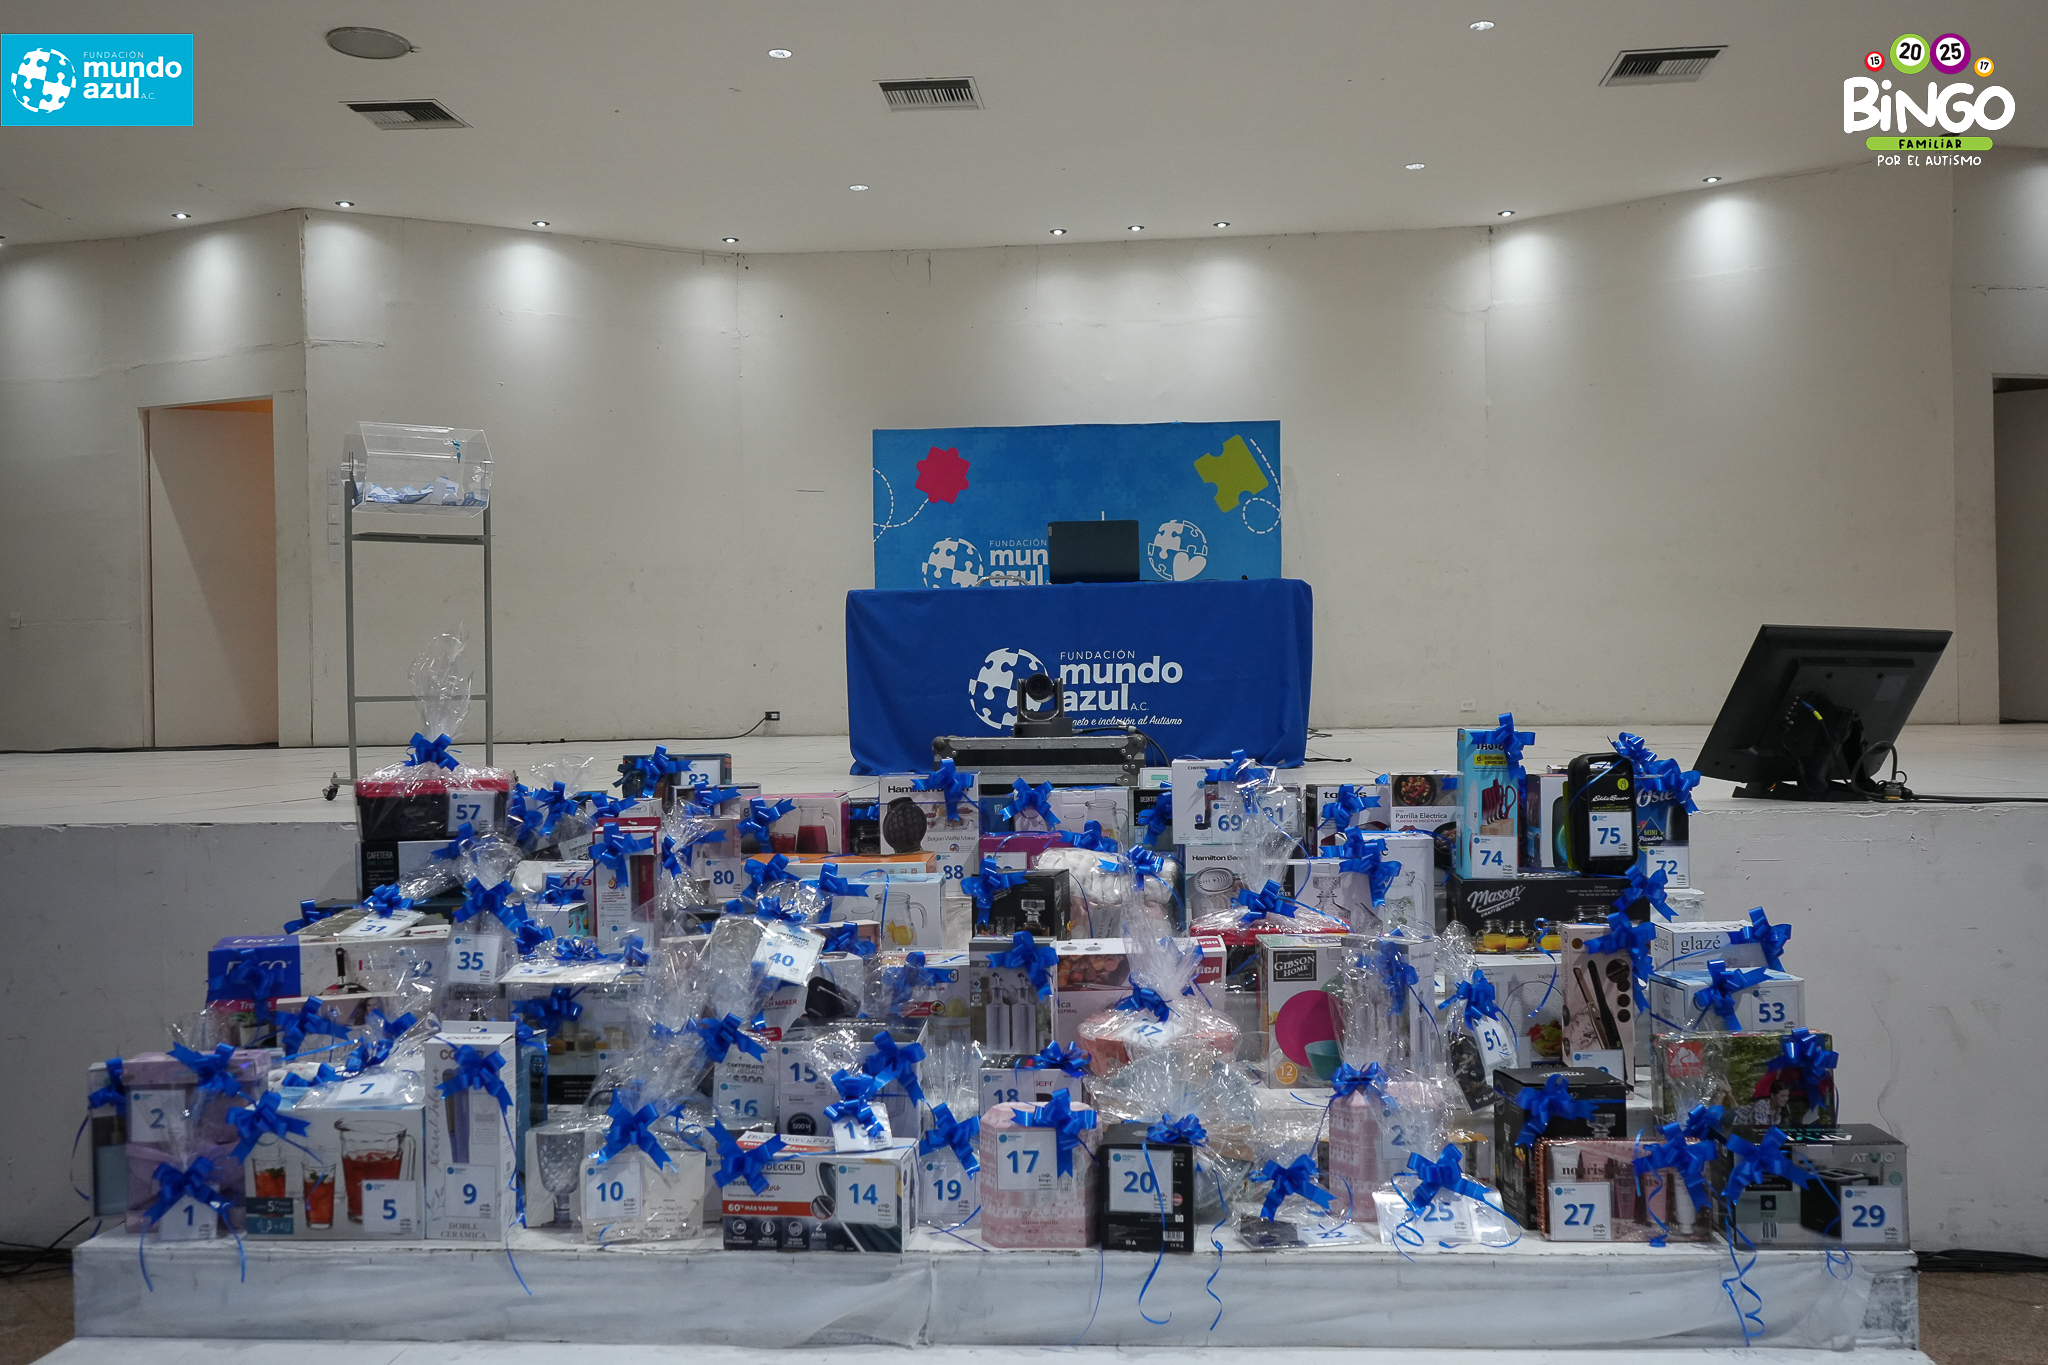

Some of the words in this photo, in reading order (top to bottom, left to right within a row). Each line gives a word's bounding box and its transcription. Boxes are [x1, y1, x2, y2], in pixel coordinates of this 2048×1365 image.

[989, 539, 1047, 547] FUNDACIÓN
[990, 548, 1049, 566] mun
[1060, 649, 1136, 660] FUNDACIÓN
[1060, 655, 1183, 685] mundo
[1063, 683, 1129, 712] azul
[1130, 702, 1150, 711] A.C.
[1138, 715, 1148, 725] al
[1149, 715, 1183, 726] Autismo
[688, 773, 710, 786] 83
[456, 804, 481, 820] 57
[1419, 811, 1448, 819] Eléctrica
[1218, 814, 1243, 832] 69
[1597, 827, 1621, 845] 75
[366, 851, 394, 860] CAFETERA
[1480, 850, 1504, 866] 74
[943, 864, 964, 880] 88
[1656, 860, 1678, 875] 72
[563, 876, 592, 886] T-fa
[713, 870, 735, 885] 80
[1680, 935, 1721, 954] glazé
[457, 951, 484, 971] 35
[769, 952, 795, 967] 40
[1274, 955, 1316, 971] GIBSON
[1283, 964, 1309, 978] HOME
[240, 1001, 272, 1011] Tres
[1758, 1002, 1785, 1023] 53
[1484, 1028, 1501, 1051] 51
[789, 1062, 818, 1083] 15
[1280, 1065, 1293, 1077] 12
[359, 1083, 375, 1094] 7
[993, 1088, 1020, 1103] 18
[730, 1099, 758, 1118] 16
[150, 1108, 165, 1129] 2
[1006, 1150, 1040, 1174] 17
[1850, 1152, 1895, 1163] ATVIO
[933, 1179, 962, 1201] 19
[1123, 1171, 1155, 1194] 20
[462, 1183, 477, 1205] 9
[596, 1181, 624, 1202] 10
[848, 1183, 879, 1206] 14
[267, 1200, 275, 1212] 5
[383, 1198, 397, 1220] 5
[1423, 1202, 1455, 1222] 25
[183, 1204, 194, 1226] 1
[1563, 1203, 1596, 1226] 27
[1852, 1204, 1886, 1228] 29
[449, 1222, 479, 1230] DOBLE
[815, 1222, 822, 1231] 2
[440, 1230, 487, 1240] CERÁMICA
